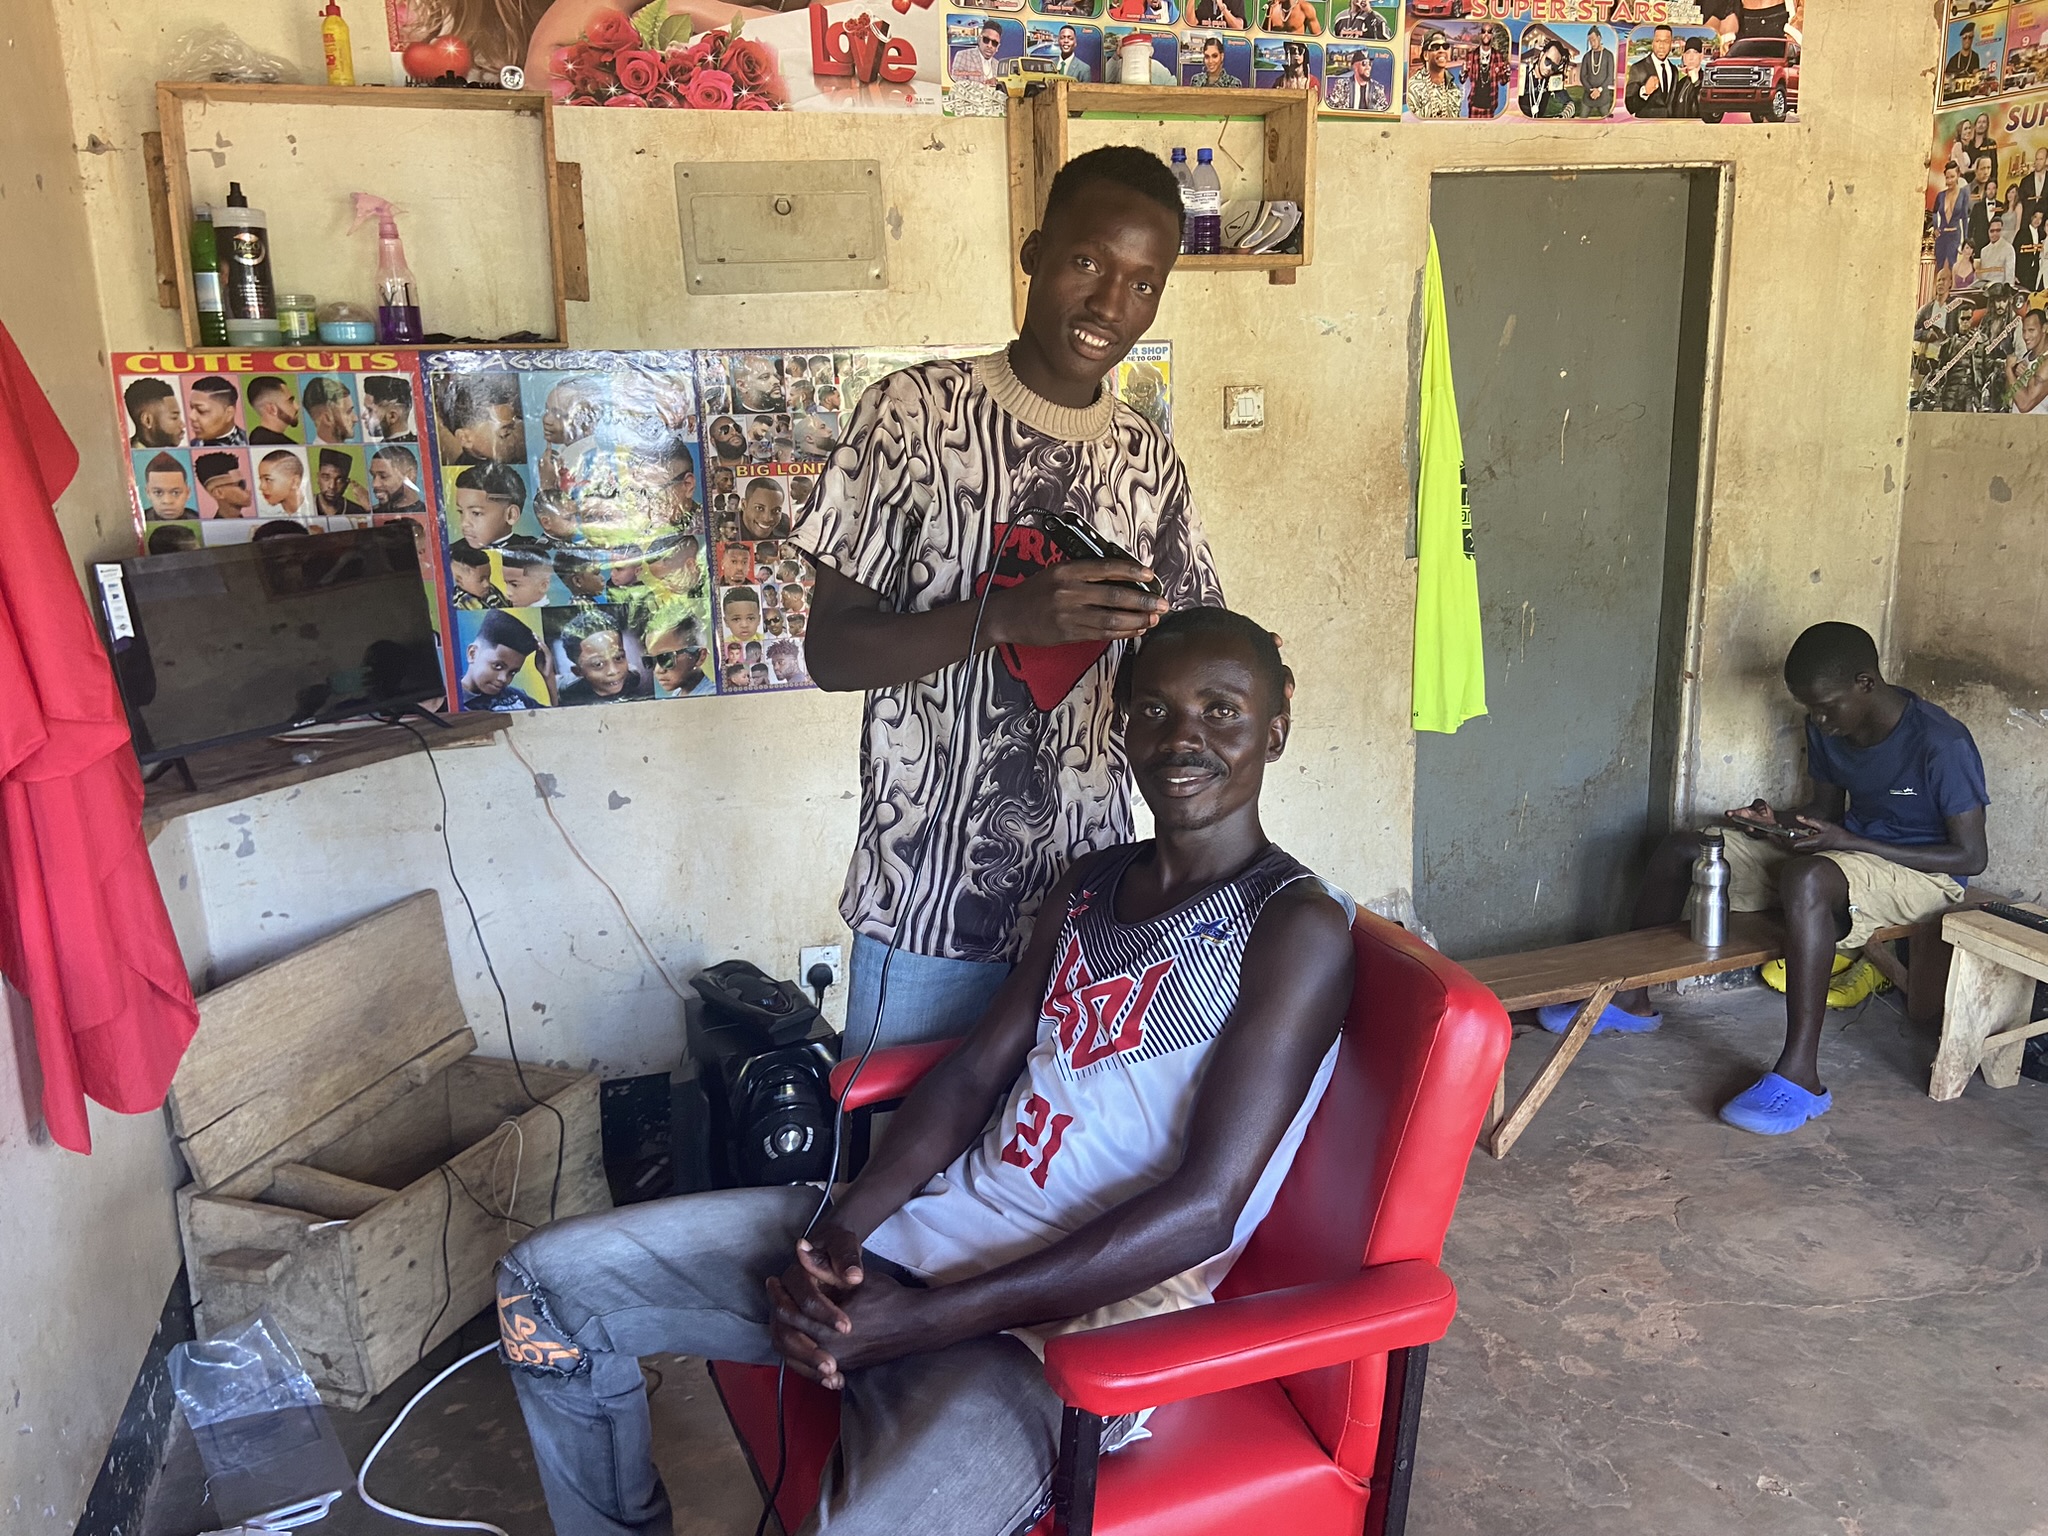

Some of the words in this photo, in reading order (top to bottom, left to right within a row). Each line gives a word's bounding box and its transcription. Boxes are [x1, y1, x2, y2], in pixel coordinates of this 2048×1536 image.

[1471, 0, 1568, 19] SUPER
[1577, 0, 1668, 23] STARS
[809, 3, 918, 84] Love
[1924, 312, 1943, 329] Bruce
[2006, 315, 2023, 332] Depp
[1141, 346, 1169, 355] SHOP
[125, 353, 254, 372] CUTE
[272, 352, 399, 371] CUTS
[736, 465, 770, 477] BIG
[1001, 1092, 1074, 1190] 21
